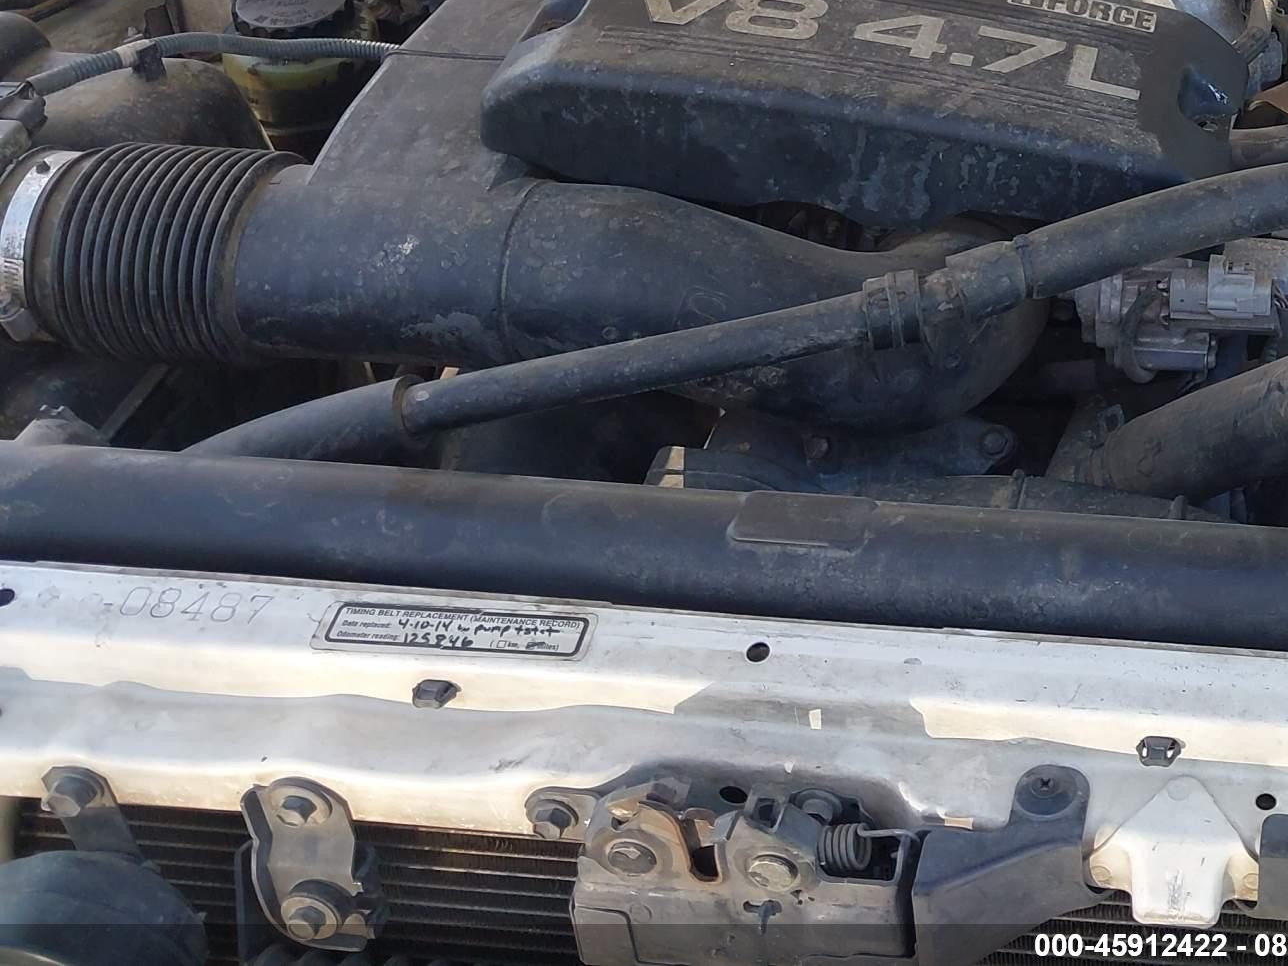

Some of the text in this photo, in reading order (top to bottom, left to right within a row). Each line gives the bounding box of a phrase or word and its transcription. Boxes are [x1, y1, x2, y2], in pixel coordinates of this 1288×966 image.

[853, 14, 1141, 101] 4.7L
[345, 607, 581, 629] TIMING BELT REPLACEMENT (MAINTENANCE RECORD)
